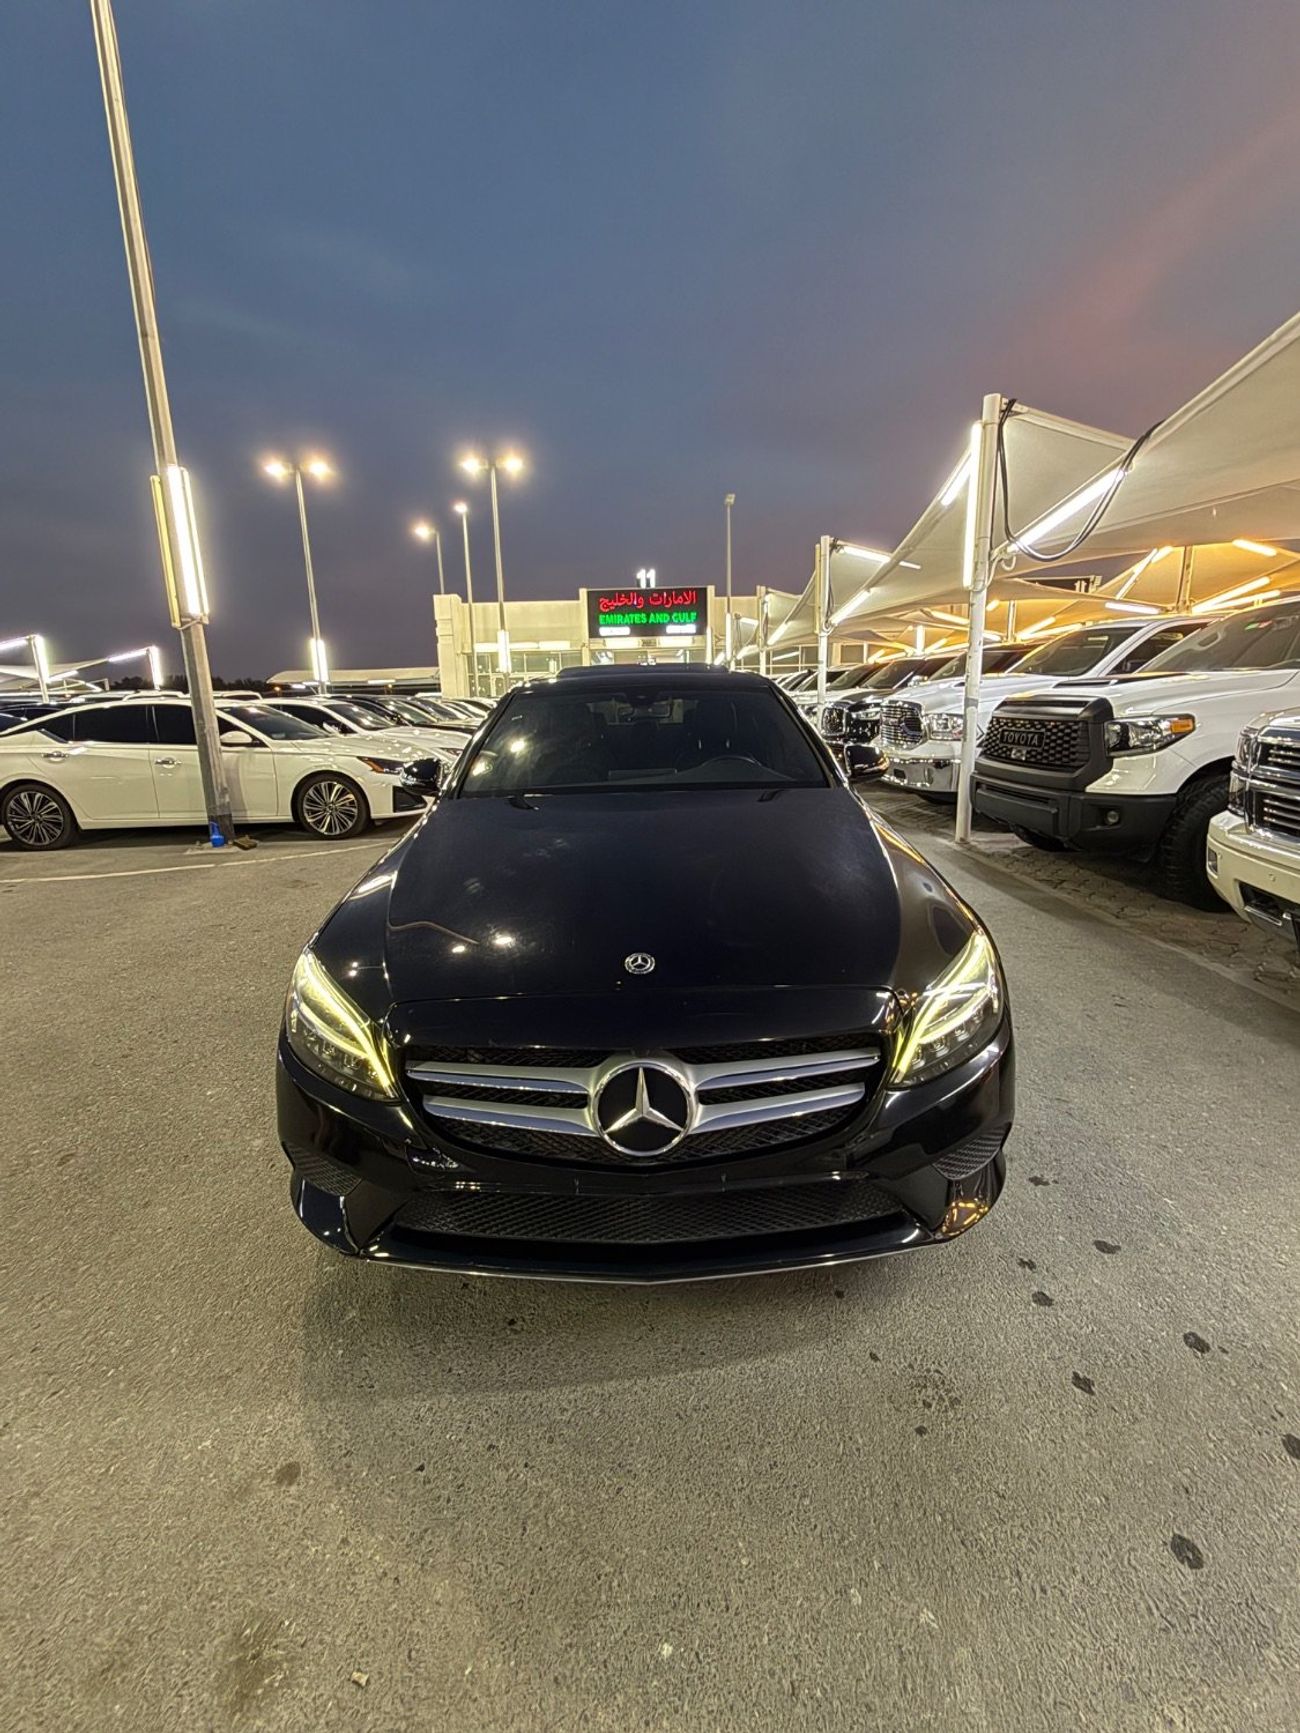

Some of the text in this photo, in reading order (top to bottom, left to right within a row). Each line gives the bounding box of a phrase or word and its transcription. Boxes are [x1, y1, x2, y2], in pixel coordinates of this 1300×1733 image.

[636, 568, 656, 589] 11
[599, 592, 645, 613] والخليج
[599, 611, 697, 625] EMIRATES AND GULF
[1003, 731, 1039, 745] TOYOTA
